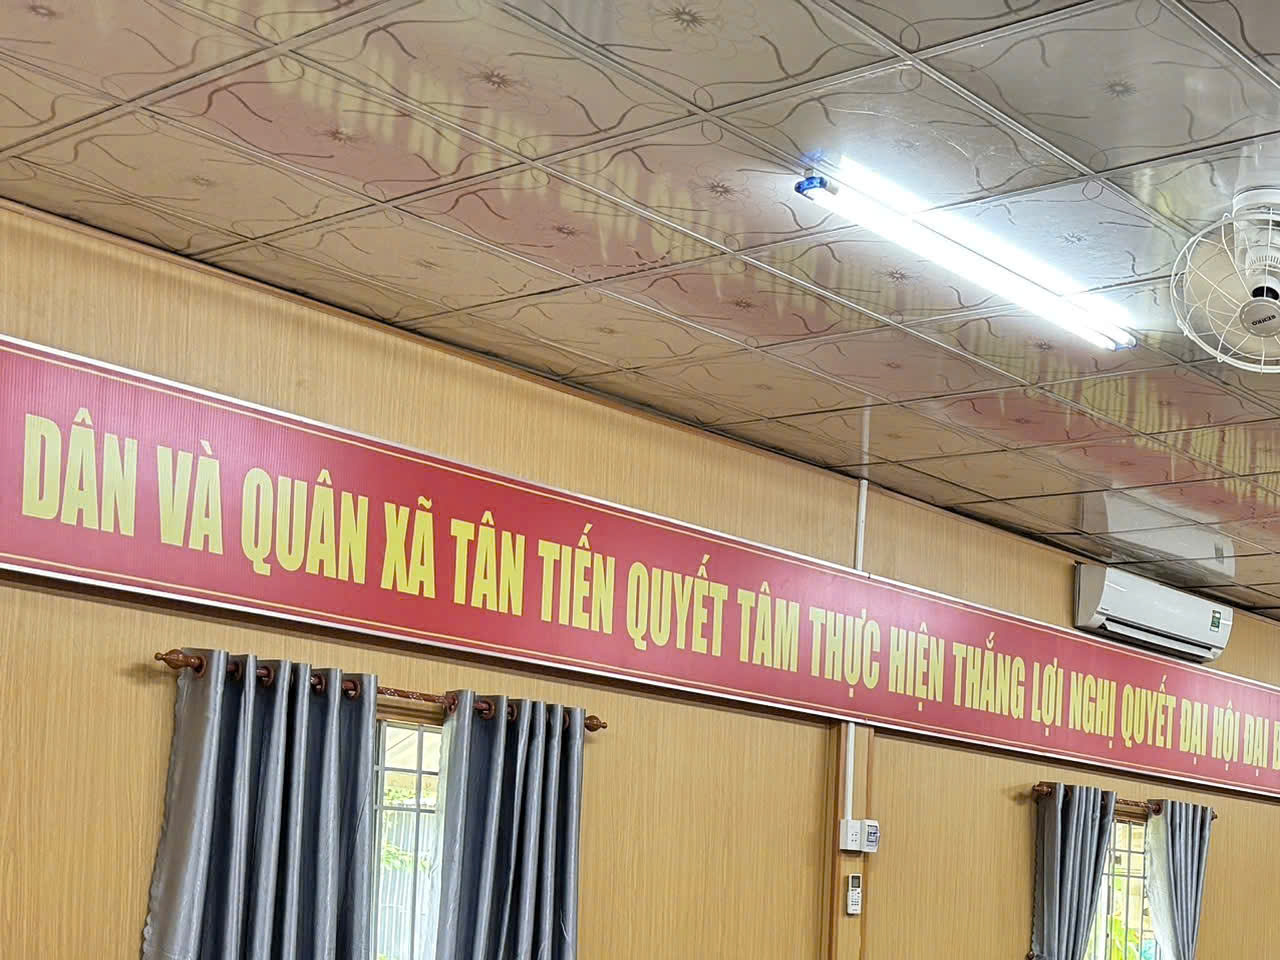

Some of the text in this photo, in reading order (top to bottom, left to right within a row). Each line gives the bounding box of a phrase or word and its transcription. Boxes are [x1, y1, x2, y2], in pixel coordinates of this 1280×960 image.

[1251, 314, 1277, 326] SENKO
[21, 406, 138, 538] DÂN
[156, 440, 225, 556] VÀ
[240, 468, 370, 586] QUÂN
[380, 495, 437, 600] XÃ
[449, 510, 526, 616] TÂN
[537, 522, 616, 635] TIẾN
[626, 553, 729, 656] QUYẾT
[737, 581, 800, 673] TÂM
[808, 608, 881, 698] THỰC
[888, 622, 945, 712] HIỆN
[952, 630, 1026, 720] THẮNG
[1031, 657, 1065, 736] LỢI
[1068, 670, 1117, 750] NGHỊ
[1120, 674, 1177, 749] QUYẾT
[1179, 697, 1210, 766] ĐẠI
[1211, 698, 1241, 772] HỘI
[1243, 713, 1270, 777] ĐẠI
